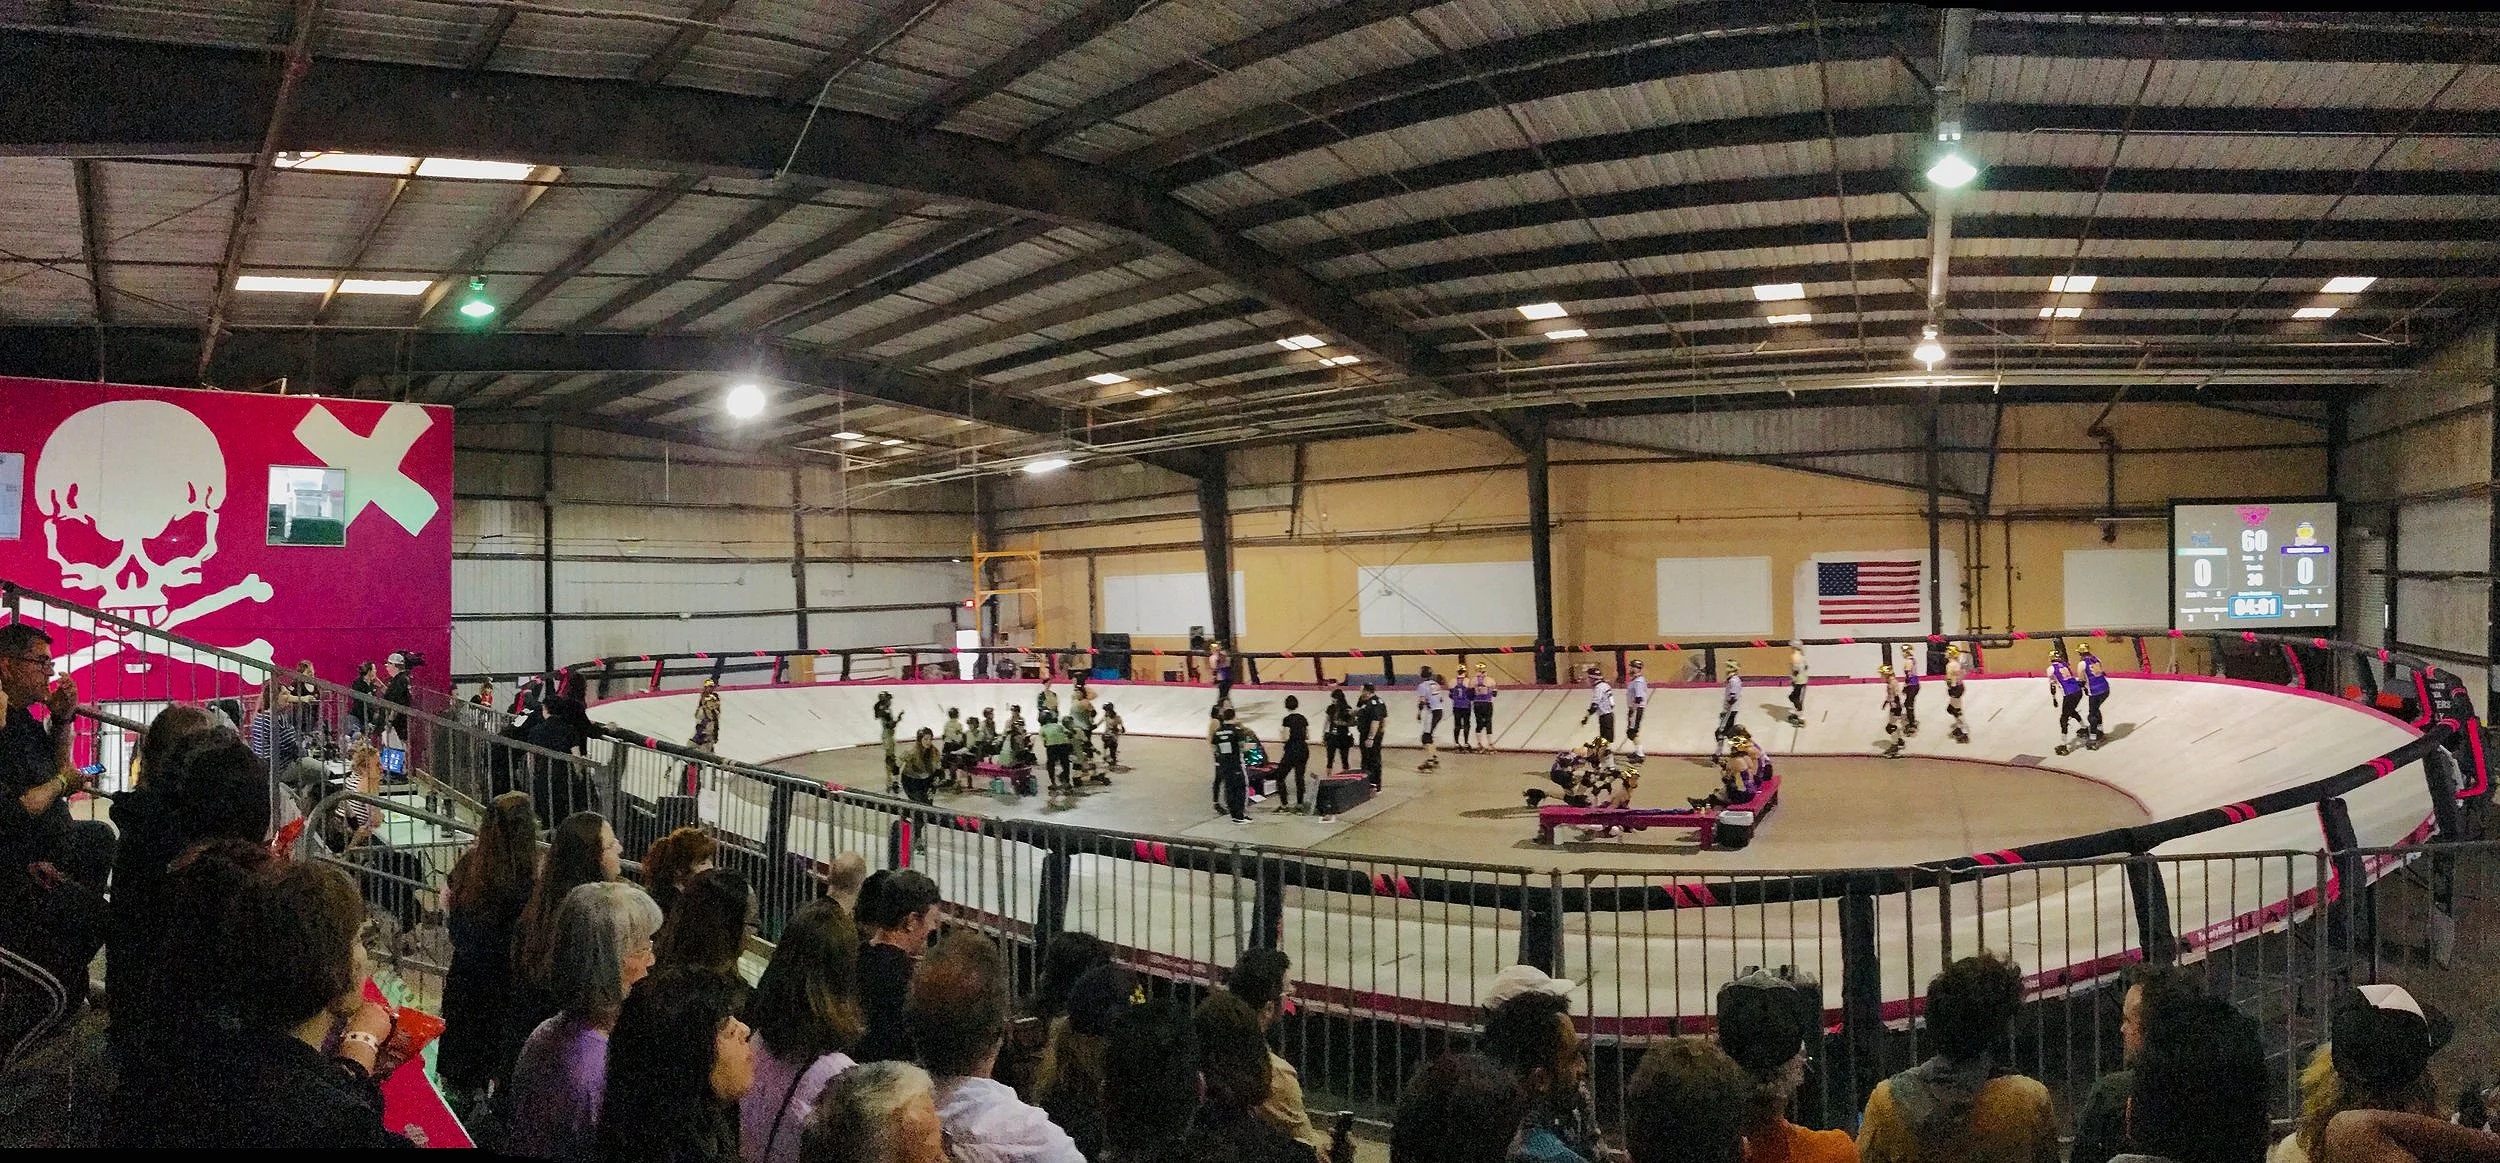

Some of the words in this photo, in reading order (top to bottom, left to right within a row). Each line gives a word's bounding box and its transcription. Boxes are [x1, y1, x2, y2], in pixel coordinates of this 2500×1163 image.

[2241, 529, 2268, 552] 60
[2194, 558, 2212, 587] 0
[2297, 556, 2314, 585] 0
